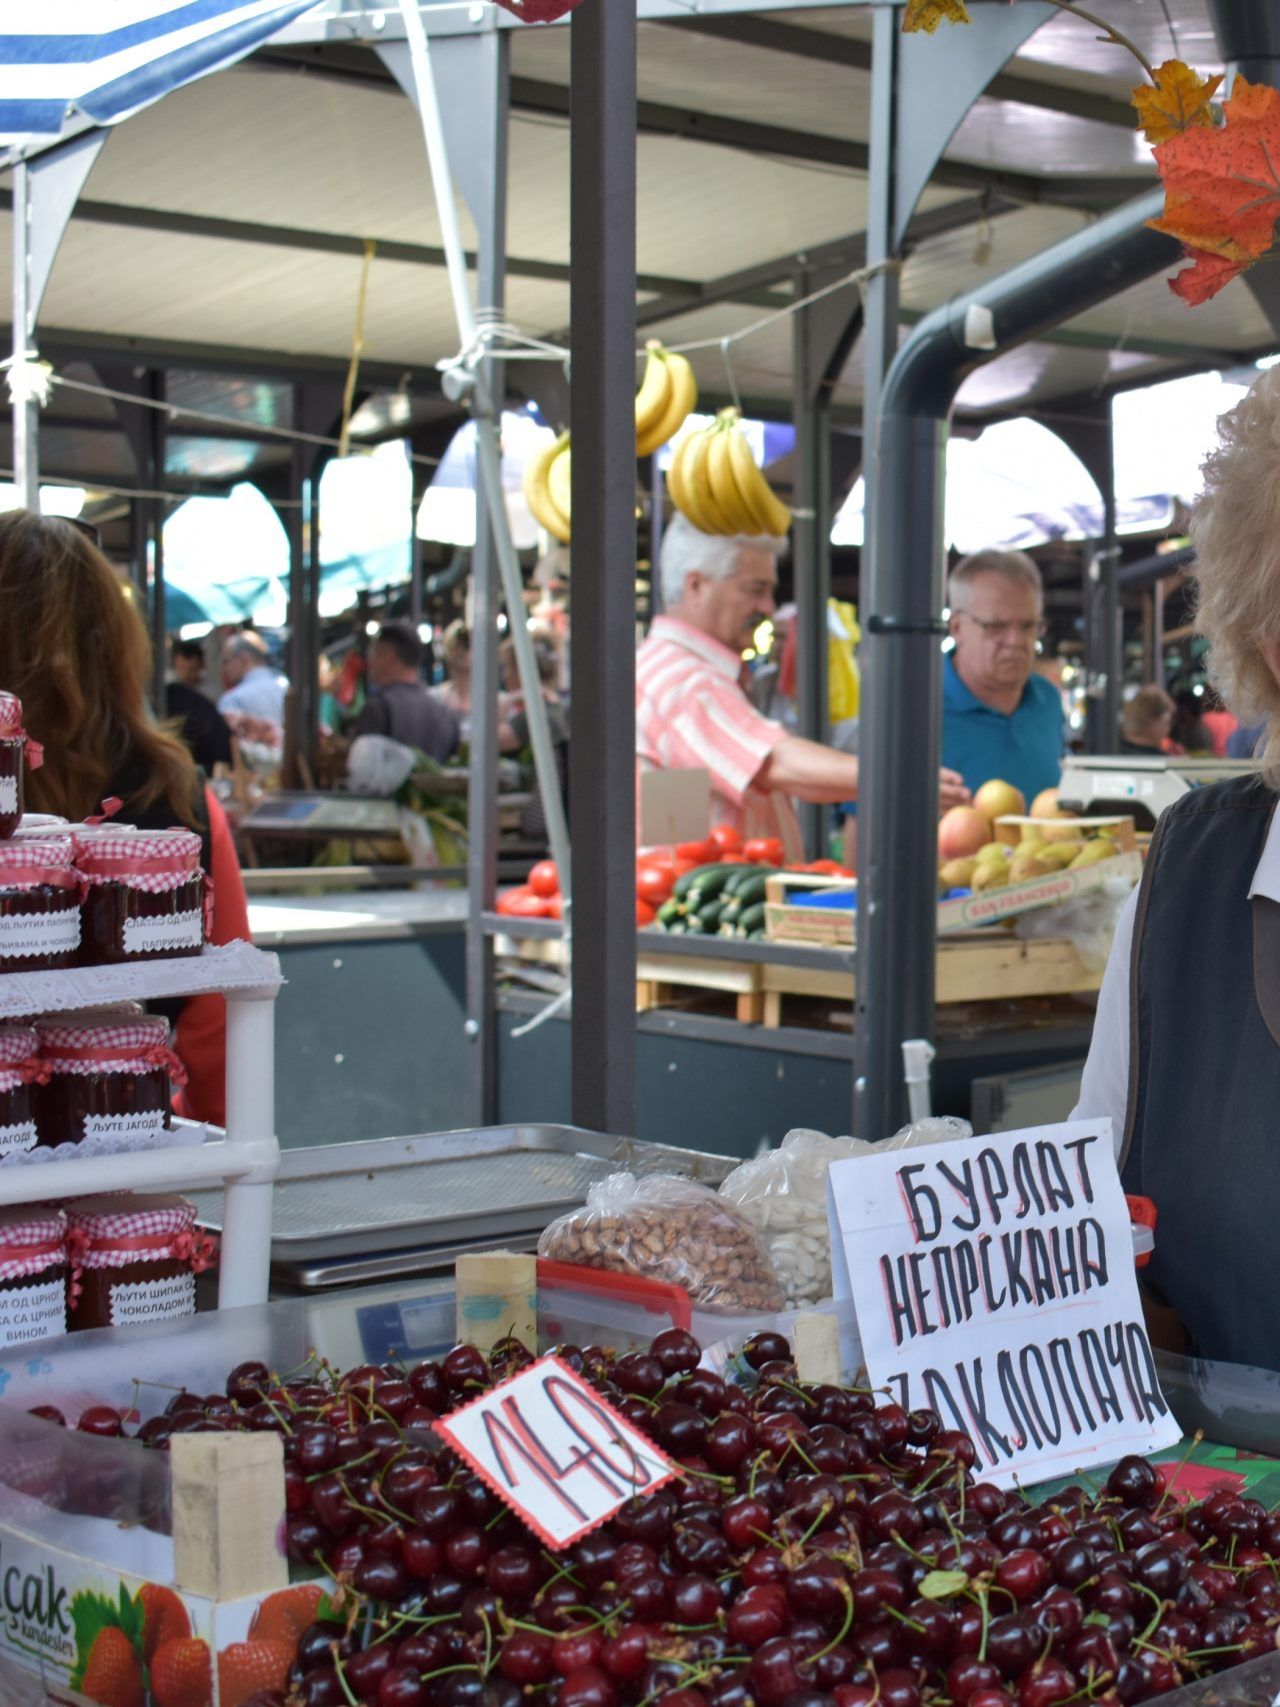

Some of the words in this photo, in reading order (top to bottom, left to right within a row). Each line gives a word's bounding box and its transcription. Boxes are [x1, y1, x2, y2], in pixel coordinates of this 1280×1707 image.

[92, 1121, 124, 1132] ЉУТЕ
[126, 1118, 159, 1131] ЈАГОДЕ
[895, 1136, 1098, 1244] БУРЛАТ
[880, 1217, 1109, 1347] НЕПРСКАНА
[115, 1290, 147, 1303] ЉУТИ
[149, 1284, 184, 1299] ШИПАК
[11, 1298, 29, 1309] ОД
[119, 1298, 186, 1316] ЧОКОЛАДОМ
[13, 1314, 28, 1325] СА
[6, 1326, 48, 1342] ВИНОМ
[481, 1376, 652, 1521] 140
